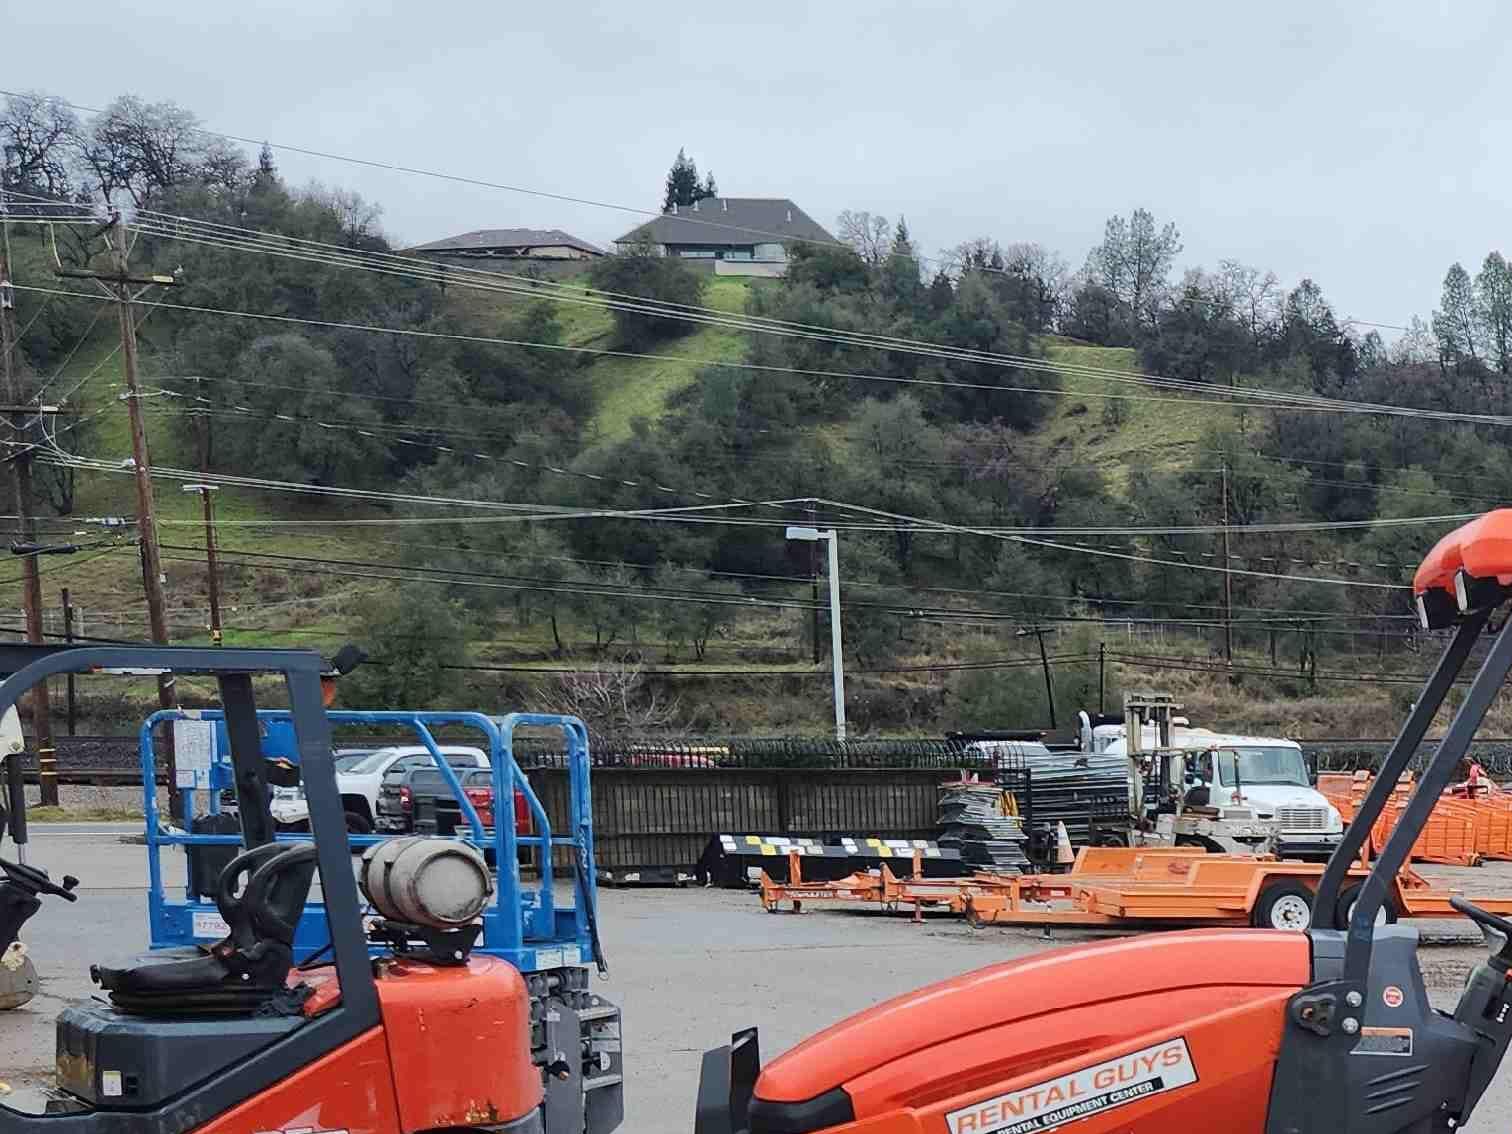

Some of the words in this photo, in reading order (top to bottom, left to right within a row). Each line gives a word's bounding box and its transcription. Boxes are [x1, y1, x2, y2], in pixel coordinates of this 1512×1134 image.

[1093, 1045, 1183, 1090] GUYS
[1042, 1097, 1109, 1126] EQUIPMENT
[1109, 1081, 1154, 1102] CENTER
